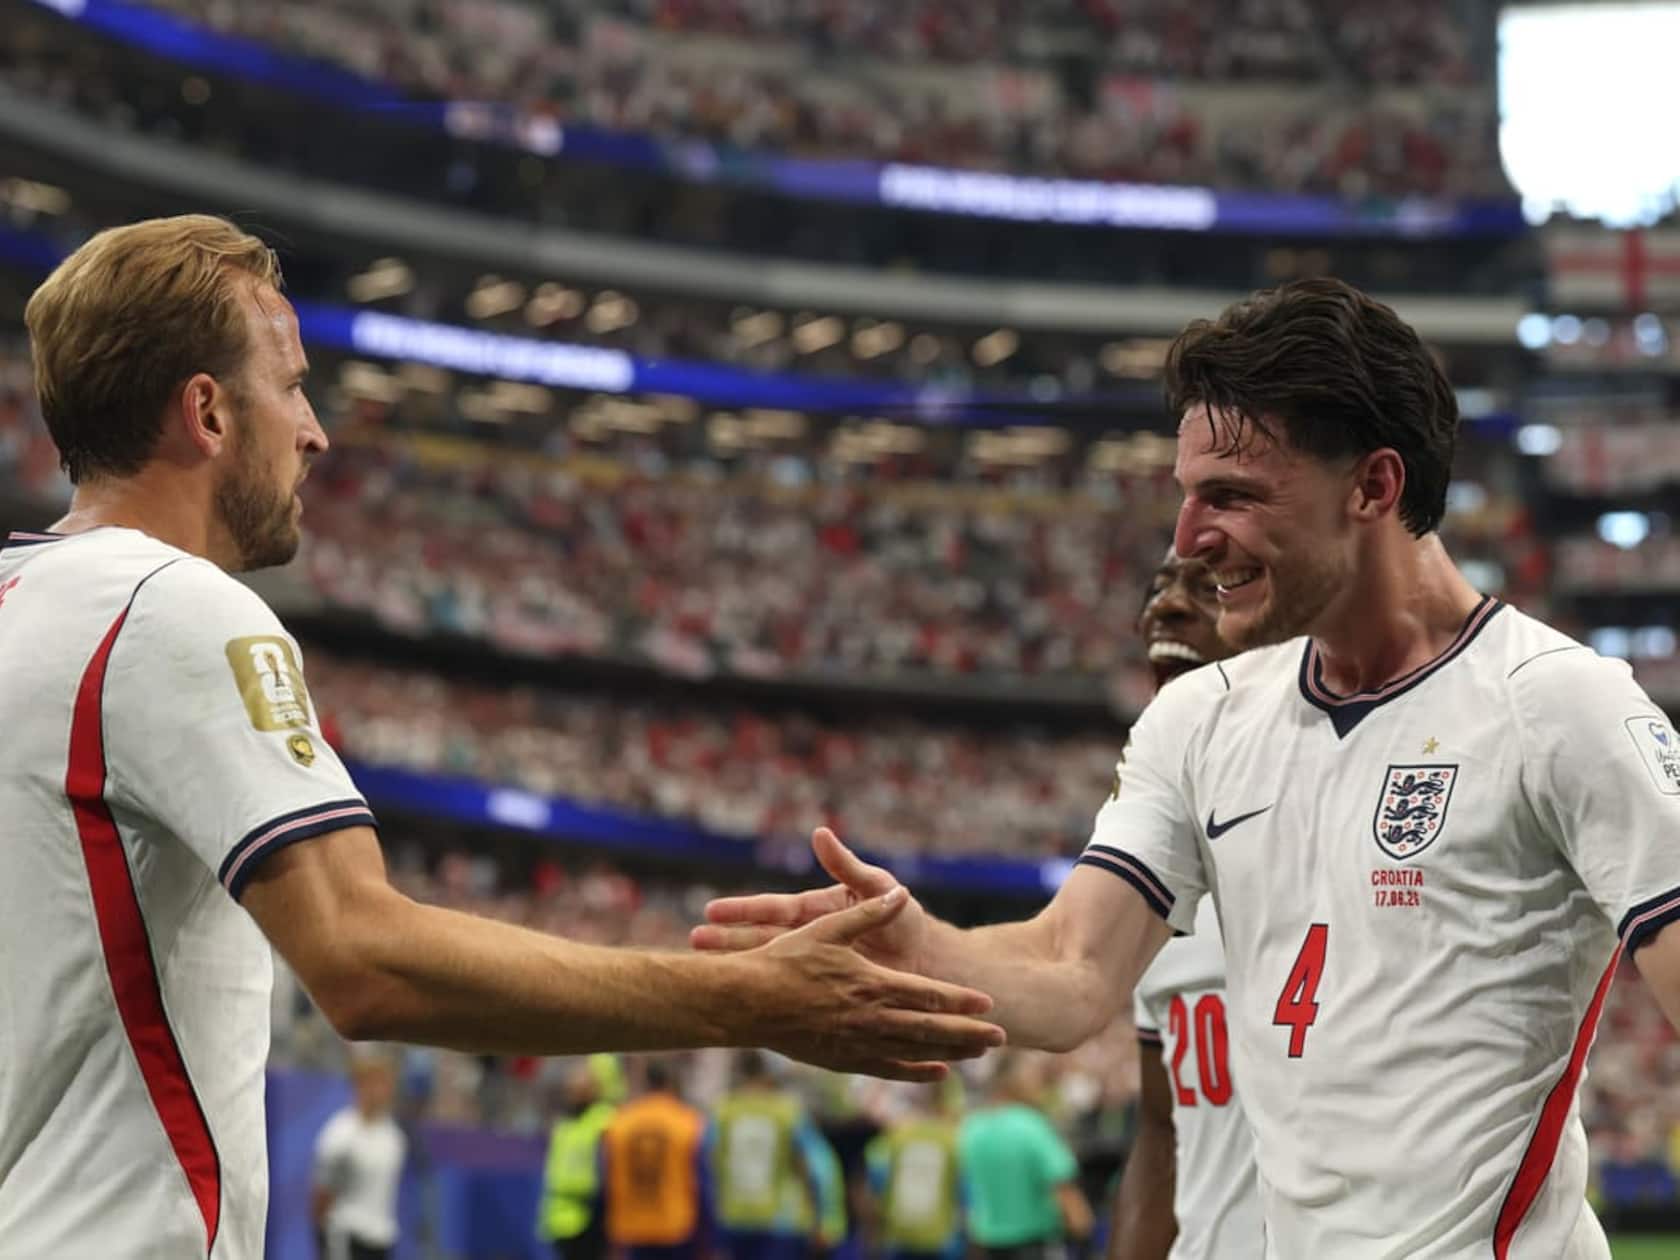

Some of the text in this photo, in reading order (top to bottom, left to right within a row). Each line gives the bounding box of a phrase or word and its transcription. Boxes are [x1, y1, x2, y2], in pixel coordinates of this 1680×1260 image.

[1371, 869, 1424, 886] CROATIA
[1272, 923, 1328, 1058] 4
[1169, 993, 1233, 1107] 20
